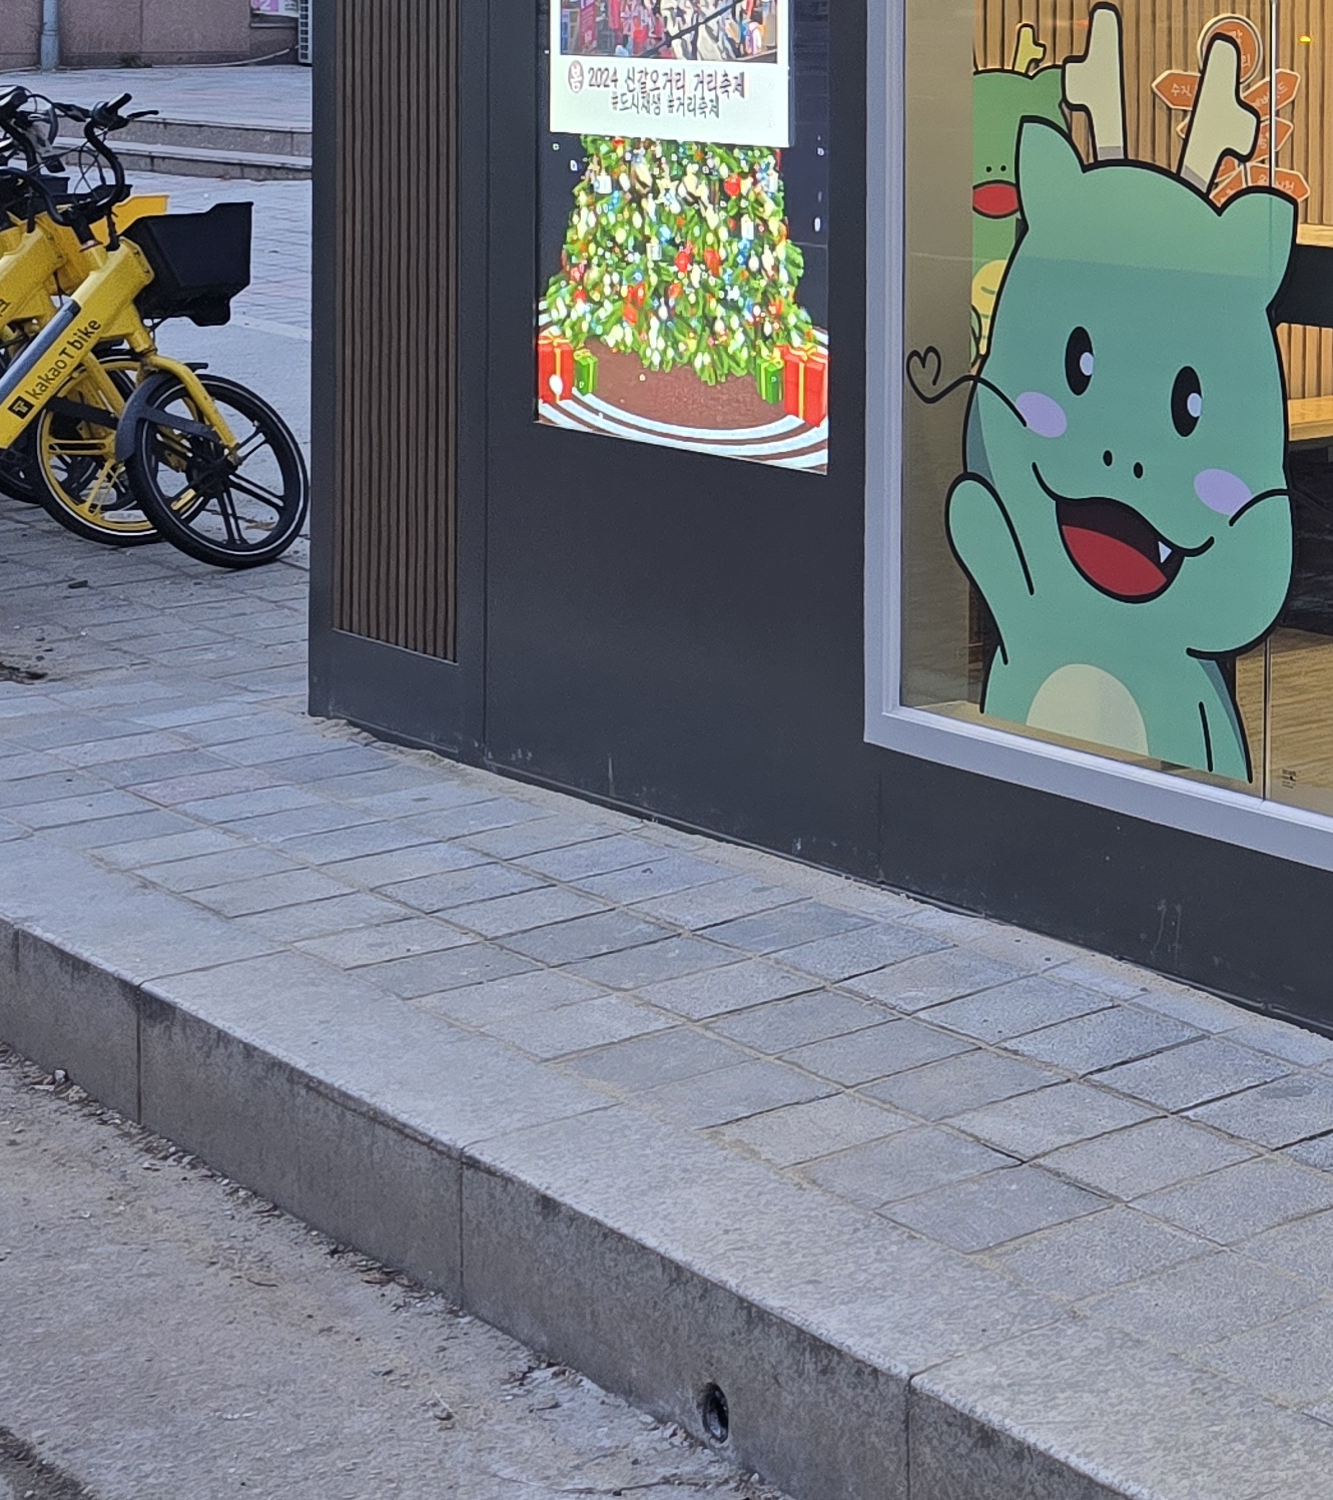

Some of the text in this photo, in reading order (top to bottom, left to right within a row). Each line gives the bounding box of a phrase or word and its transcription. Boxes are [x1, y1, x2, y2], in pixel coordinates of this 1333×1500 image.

[588, 67, 619, 89] 2024
[624, 67, 686, 96] 신갈오거리
[693, 69, 745, 99] 거리축제
[25, 359, 68, 400] kakao
[67, 319, 101, 351] bike
